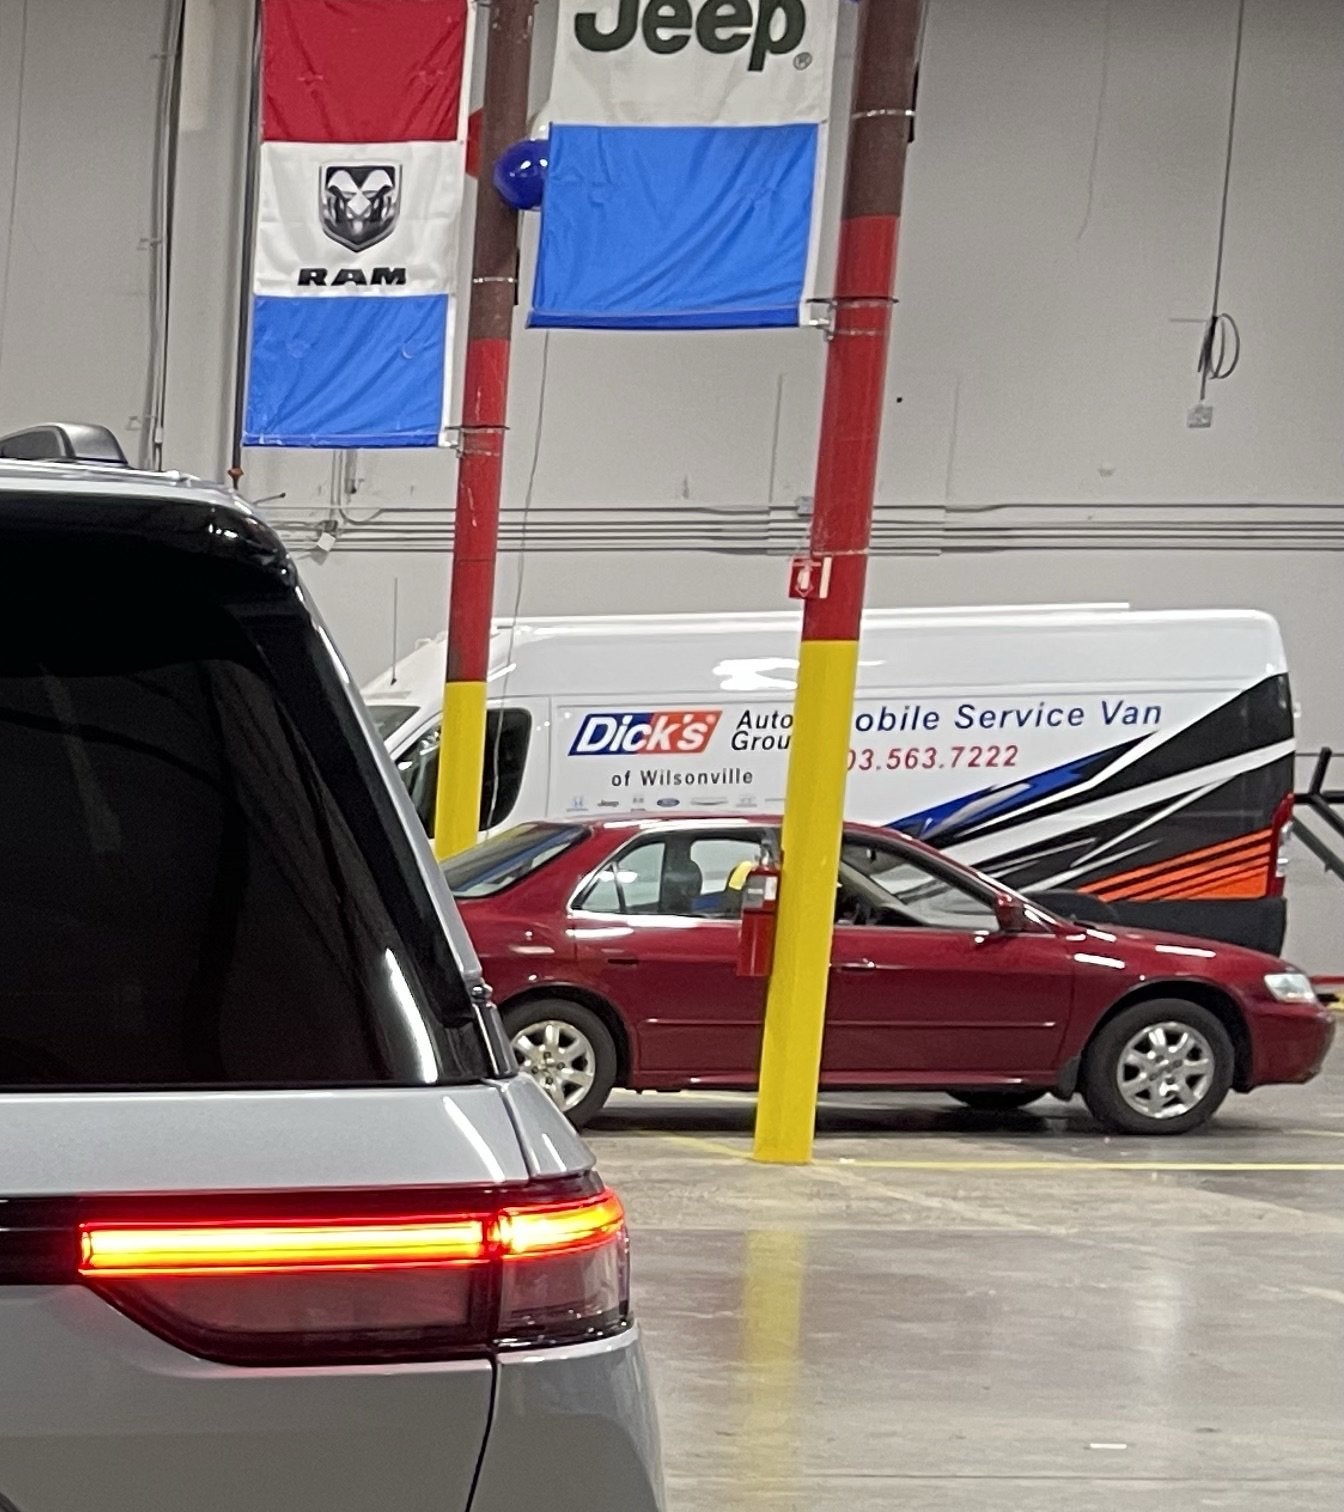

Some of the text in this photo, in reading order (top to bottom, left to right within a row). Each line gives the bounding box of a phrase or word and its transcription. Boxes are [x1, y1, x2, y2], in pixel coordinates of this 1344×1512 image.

[574, 0, 806, 72] Jeep
[297, 266, 407, 287] RAM
[736, 709, 794, 729] Auto
[855, 700, 1161, 732] obile Service Van
[575, 713, 709, 752] Dick's
[731, 730, 792, 751] Grou
[611, 767, 753, 787] of Wilsonville
